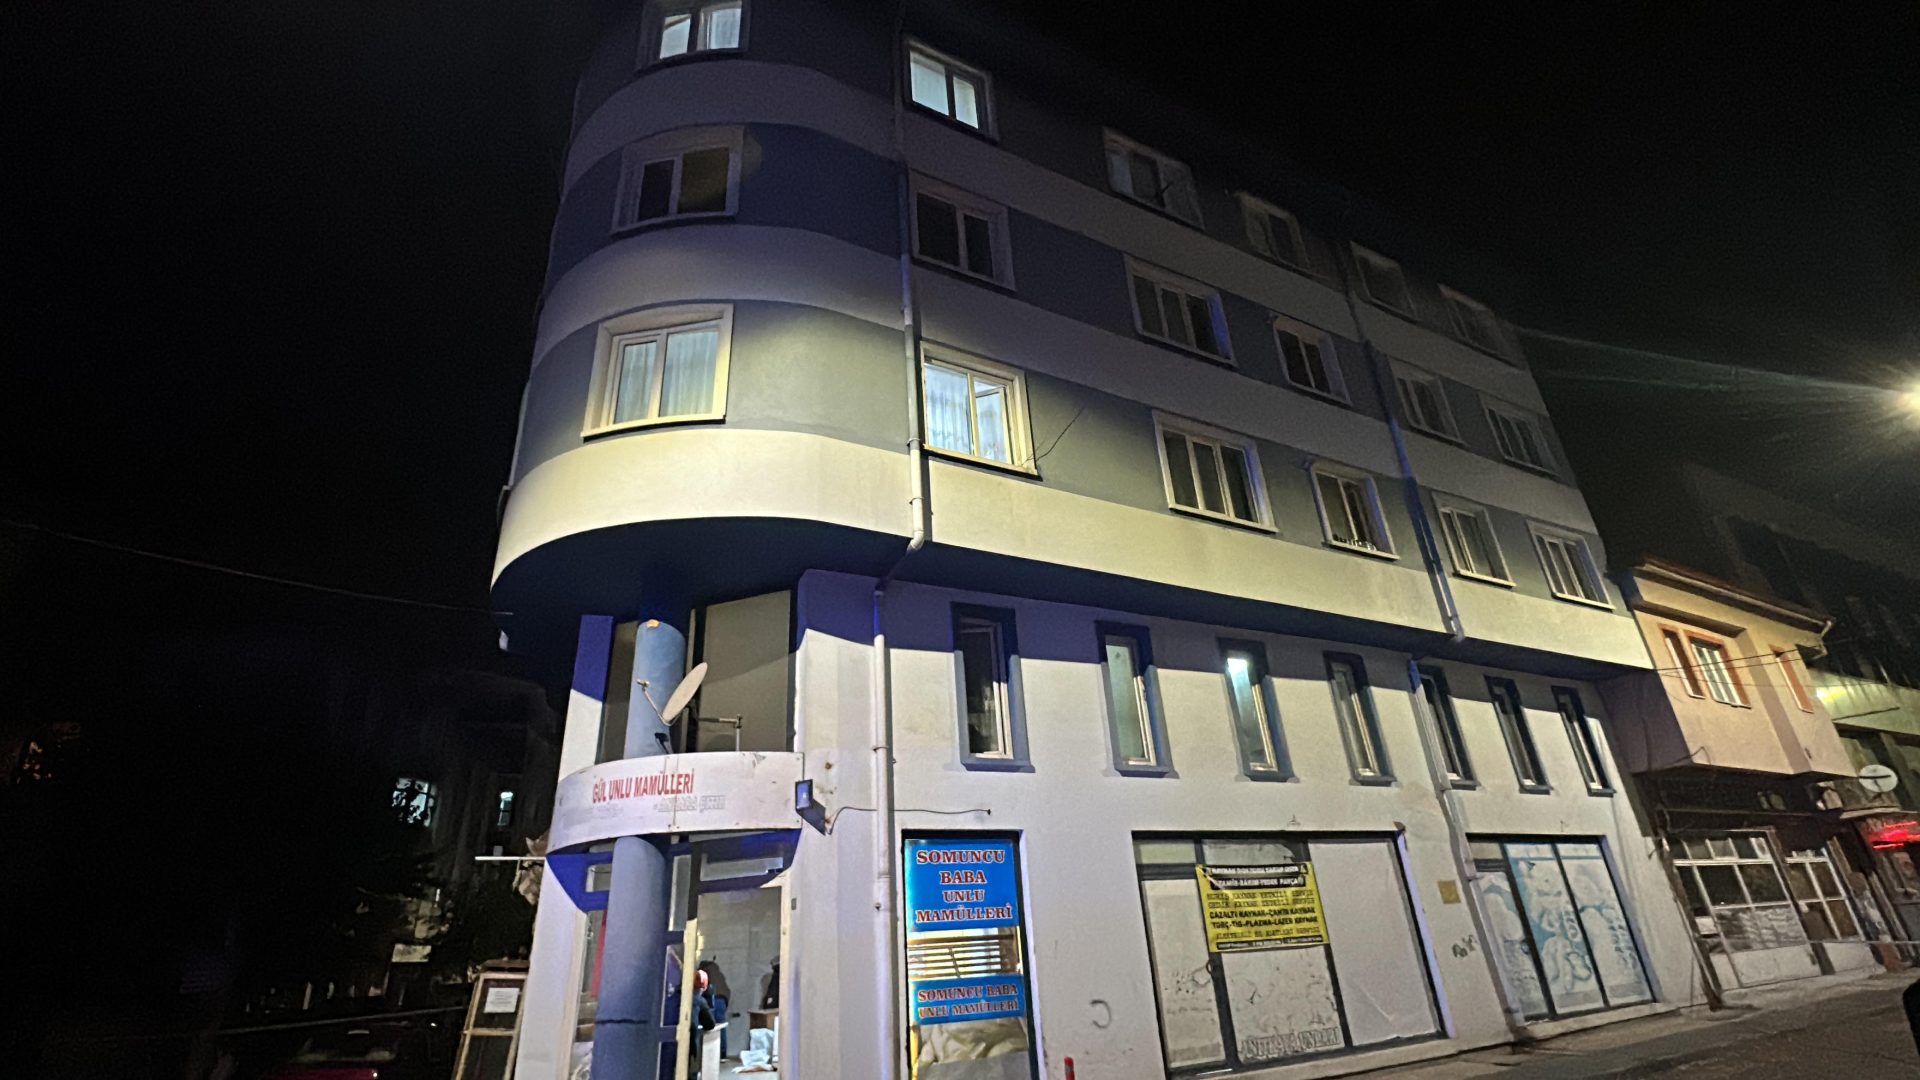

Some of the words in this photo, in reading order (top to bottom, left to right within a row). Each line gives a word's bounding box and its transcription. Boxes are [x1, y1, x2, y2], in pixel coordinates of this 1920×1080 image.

[592, 778, 606, 803] GÜL
[608, 778, 632, 800] UNLU
[634, 768, 695, 797] MAMÜLLERİ
[917, 850, 1005, 864] SOMUNCU
[939, 870, 987, 885] BABA
[943, 889, 985, 902] UNLU
[916, 902, 1013, 923] MAMÜLLERİ
[918, 985, 983, 1002] SOMUNCU
[986, 984, 1018, 997] BABA
[918, 1005, 949, 1018] UNLU
[952, 998, 1019, 1015] MAMÜLLERİ
